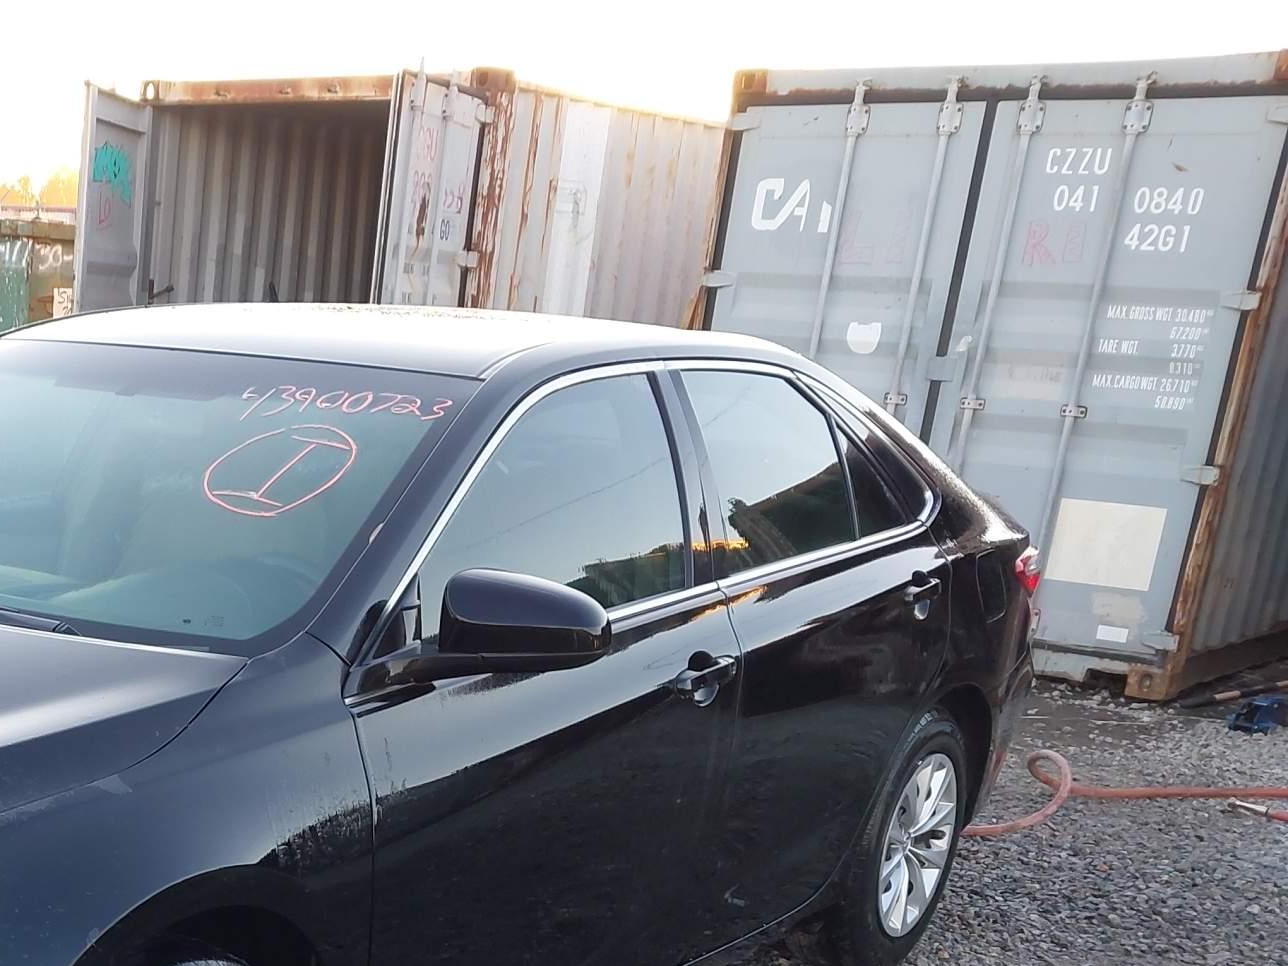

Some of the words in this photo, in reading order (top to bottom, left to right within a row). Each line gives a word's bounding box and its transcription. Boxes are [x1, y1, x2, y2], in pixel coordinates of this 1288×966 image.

[1046, 147, 1112, 175] CZZU
[1053, 184, 1099, 212] 041
[1134, 187, 1205, 215] 0840
[1124, 223, 1191, 253] 42G1
[1129, 306, 1155, 320] GROSS
[1098, 339, 1119, 353] TARE
[1113, 375, 1140, 389] CARGO
[239, 385, 453, 421] 43900723
